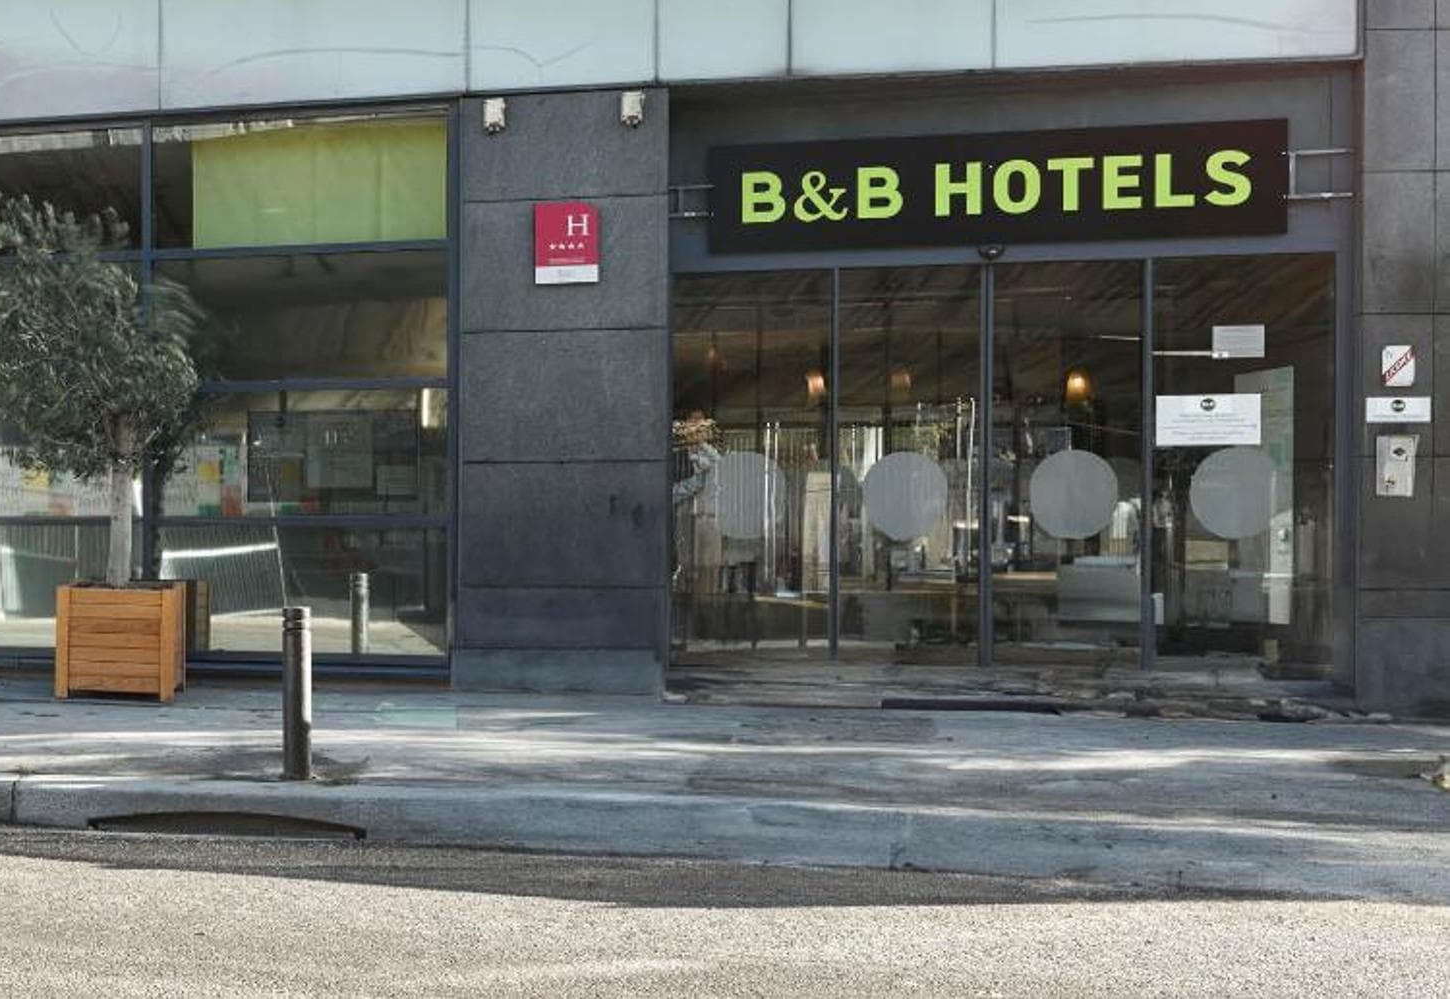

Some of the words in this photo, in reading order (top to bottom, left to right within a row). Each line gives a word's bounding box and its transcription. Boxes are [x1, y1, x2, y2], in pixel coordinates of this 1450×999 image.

[742, 167, 903, 222] B&B
[935, 151, 1250, 217] HOTELS
[566, 214, 589, 236] H
